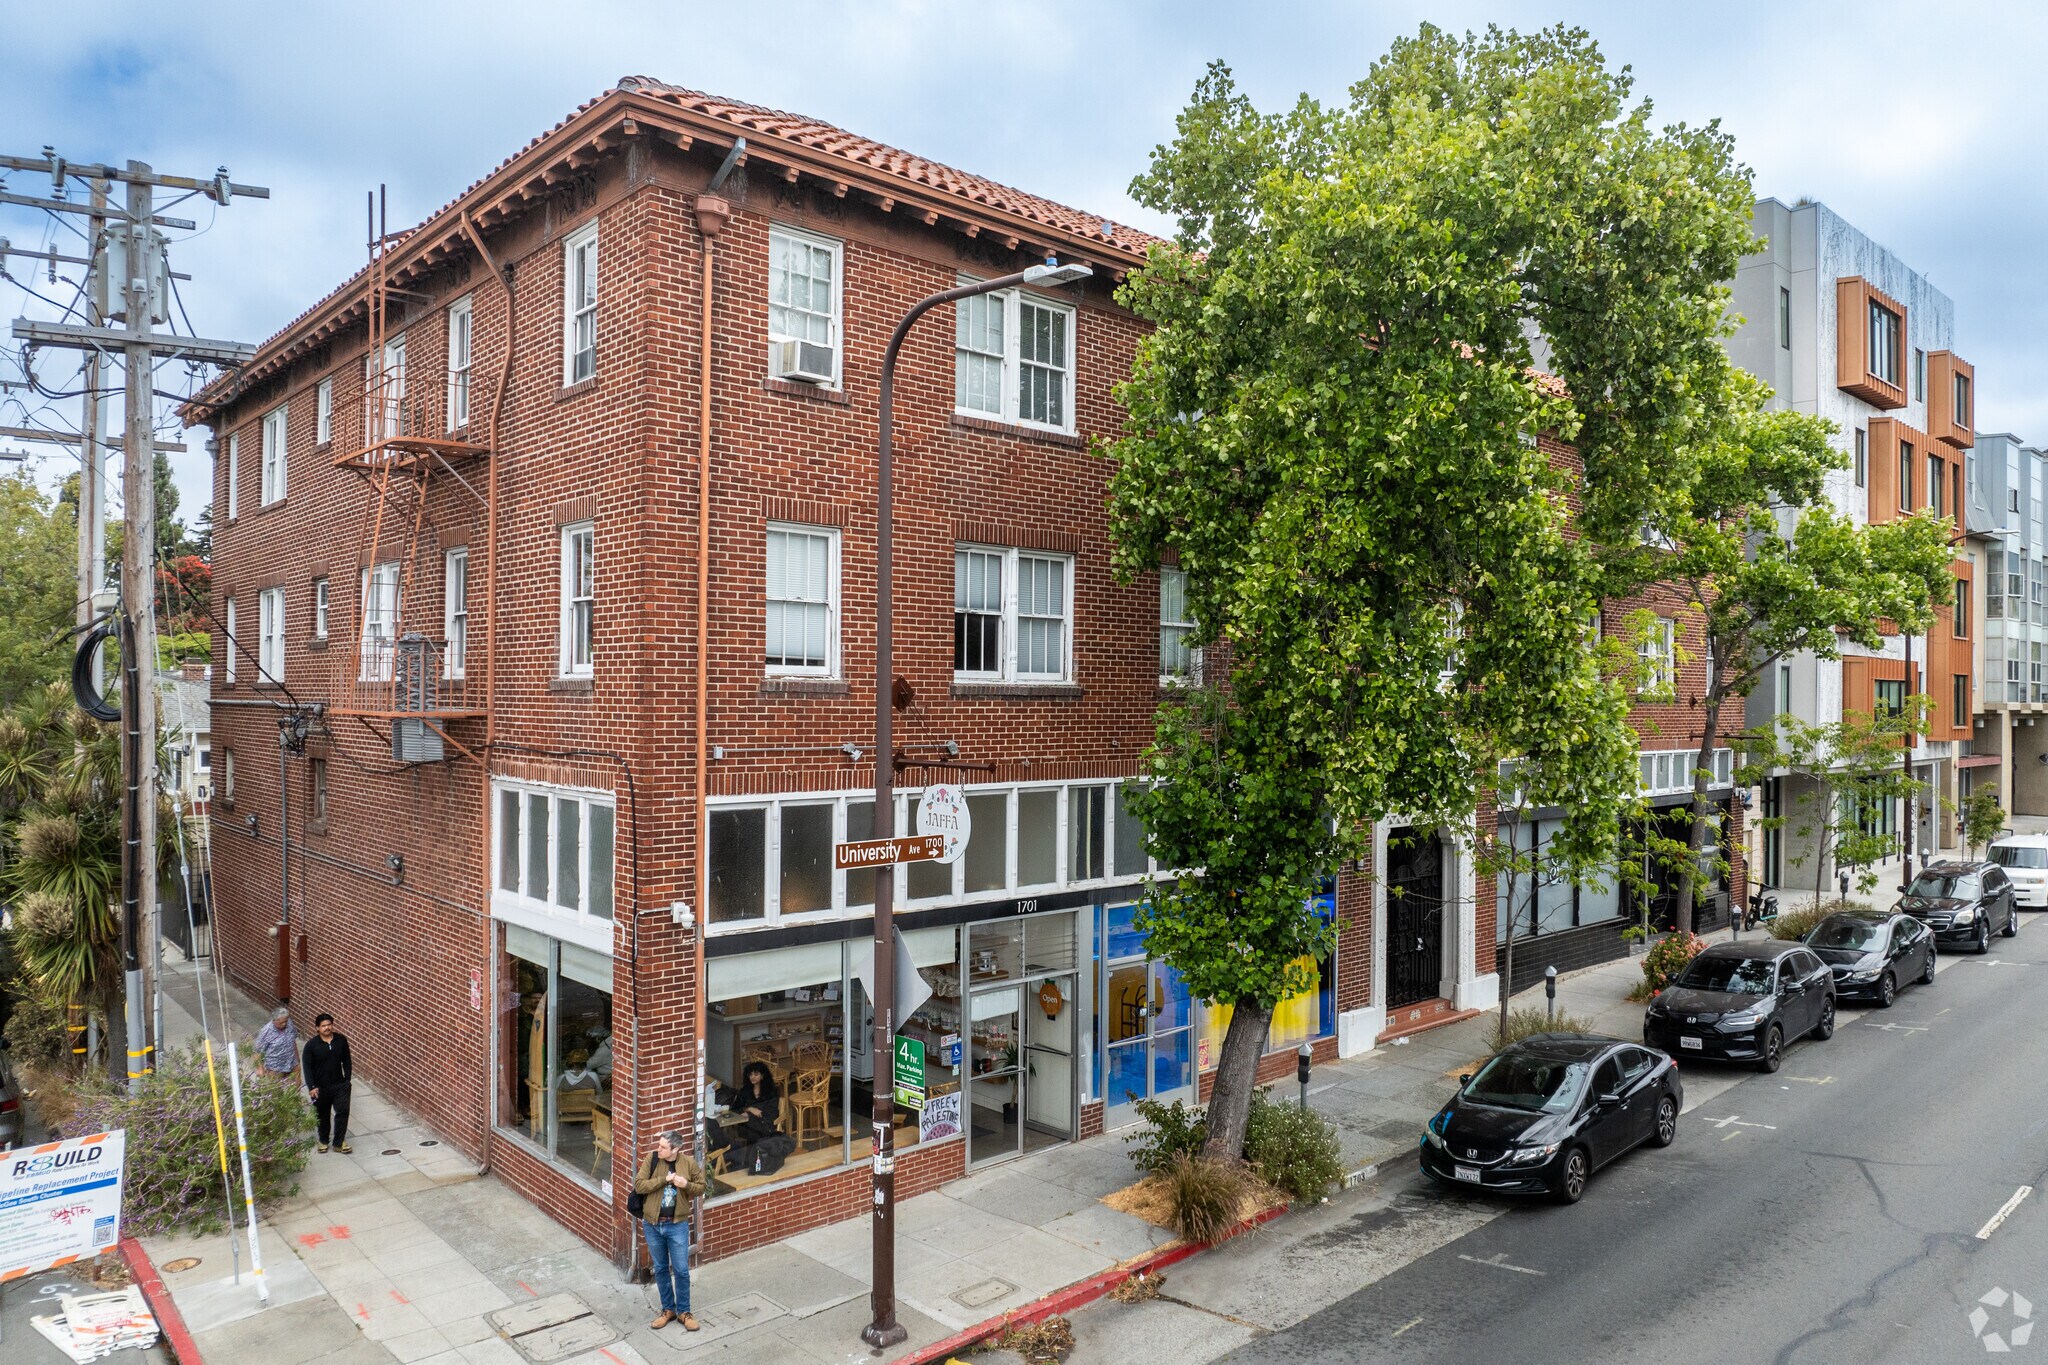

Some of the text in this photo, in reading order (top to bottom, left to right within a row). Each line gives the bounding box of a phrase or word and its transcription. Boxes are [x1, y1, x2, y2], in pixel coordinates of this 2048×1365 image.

[925, 812, 959, 830] JAFFA
[839, 837, 943, 864] University Ave 1700
[1017, 899, 1037, 914] 1701
[1042, 993, 1058, 1005] Open
[899, 1041, 920, 1066] 4 hr.
[906, 1064, 923, 1076] Parking
[931, 1096, 952, 1112] FREE
[921, 1110, 959, 1132] PALESTINE
[32, 1174, 88, 1193] Replacement
[89, 1168, 119, 1181] Project
